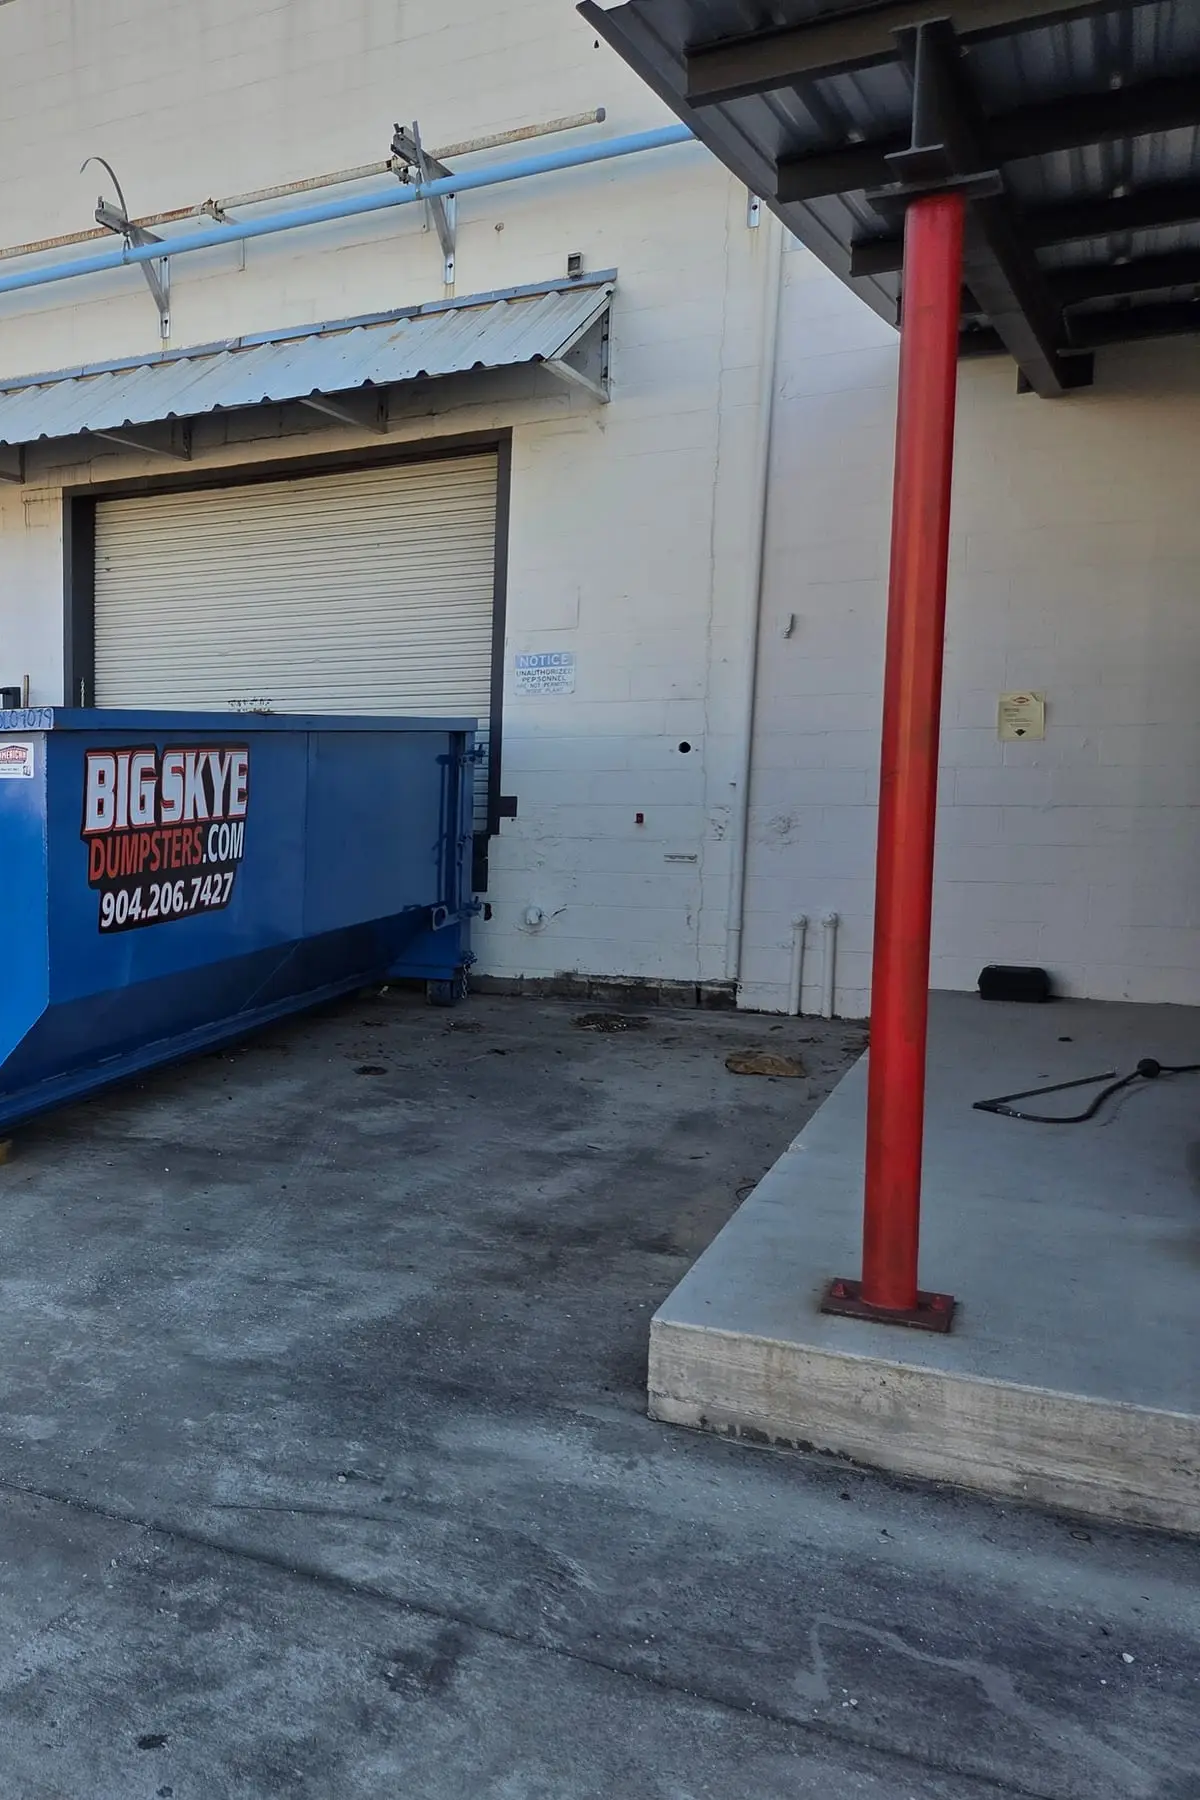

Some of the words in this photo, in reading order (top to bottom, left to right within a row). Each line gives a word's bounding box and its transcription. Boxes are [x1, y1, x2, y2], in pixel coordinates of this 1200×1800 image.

[516, 668, 572, 677] UNAUTHORIZED
[520, 653, 569, 667] NOTICE
[83, 751, 158, 834] BIG
[160, 749, 249, 825] SKYE
[89, 822, 244, 881] DUMPSTERS.COM
[101, 871, 234, 928] 904.206.7427
